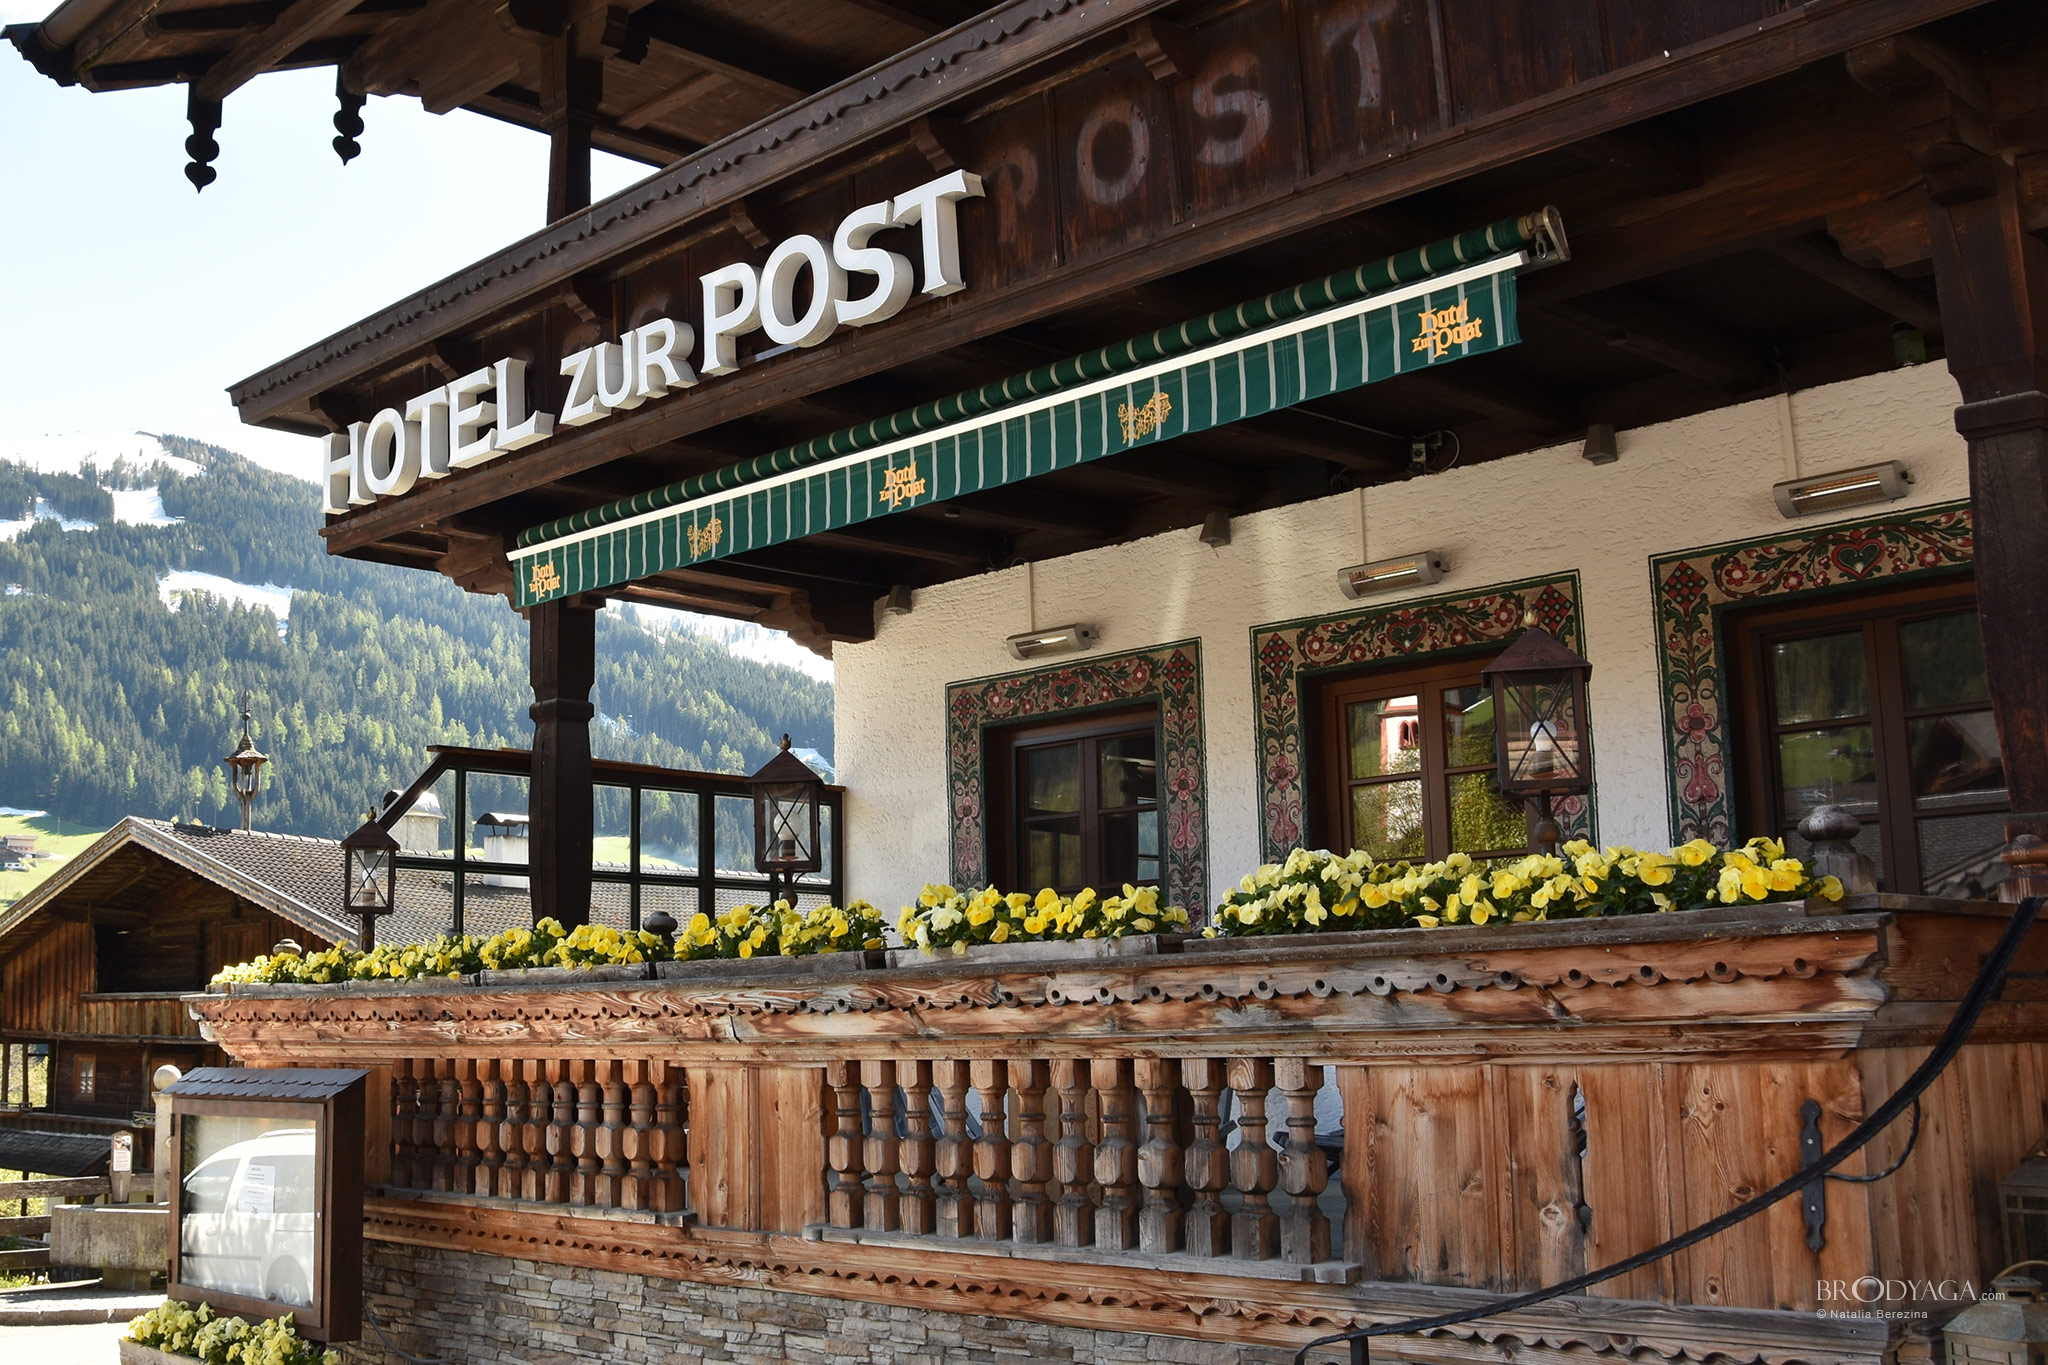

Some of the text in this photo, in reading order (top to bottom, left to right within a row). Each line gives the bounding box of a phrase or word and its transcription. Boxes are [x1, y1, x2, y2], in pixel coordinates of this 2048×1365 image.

[322, 170, 985, 515] HOTEL ZUR POST
